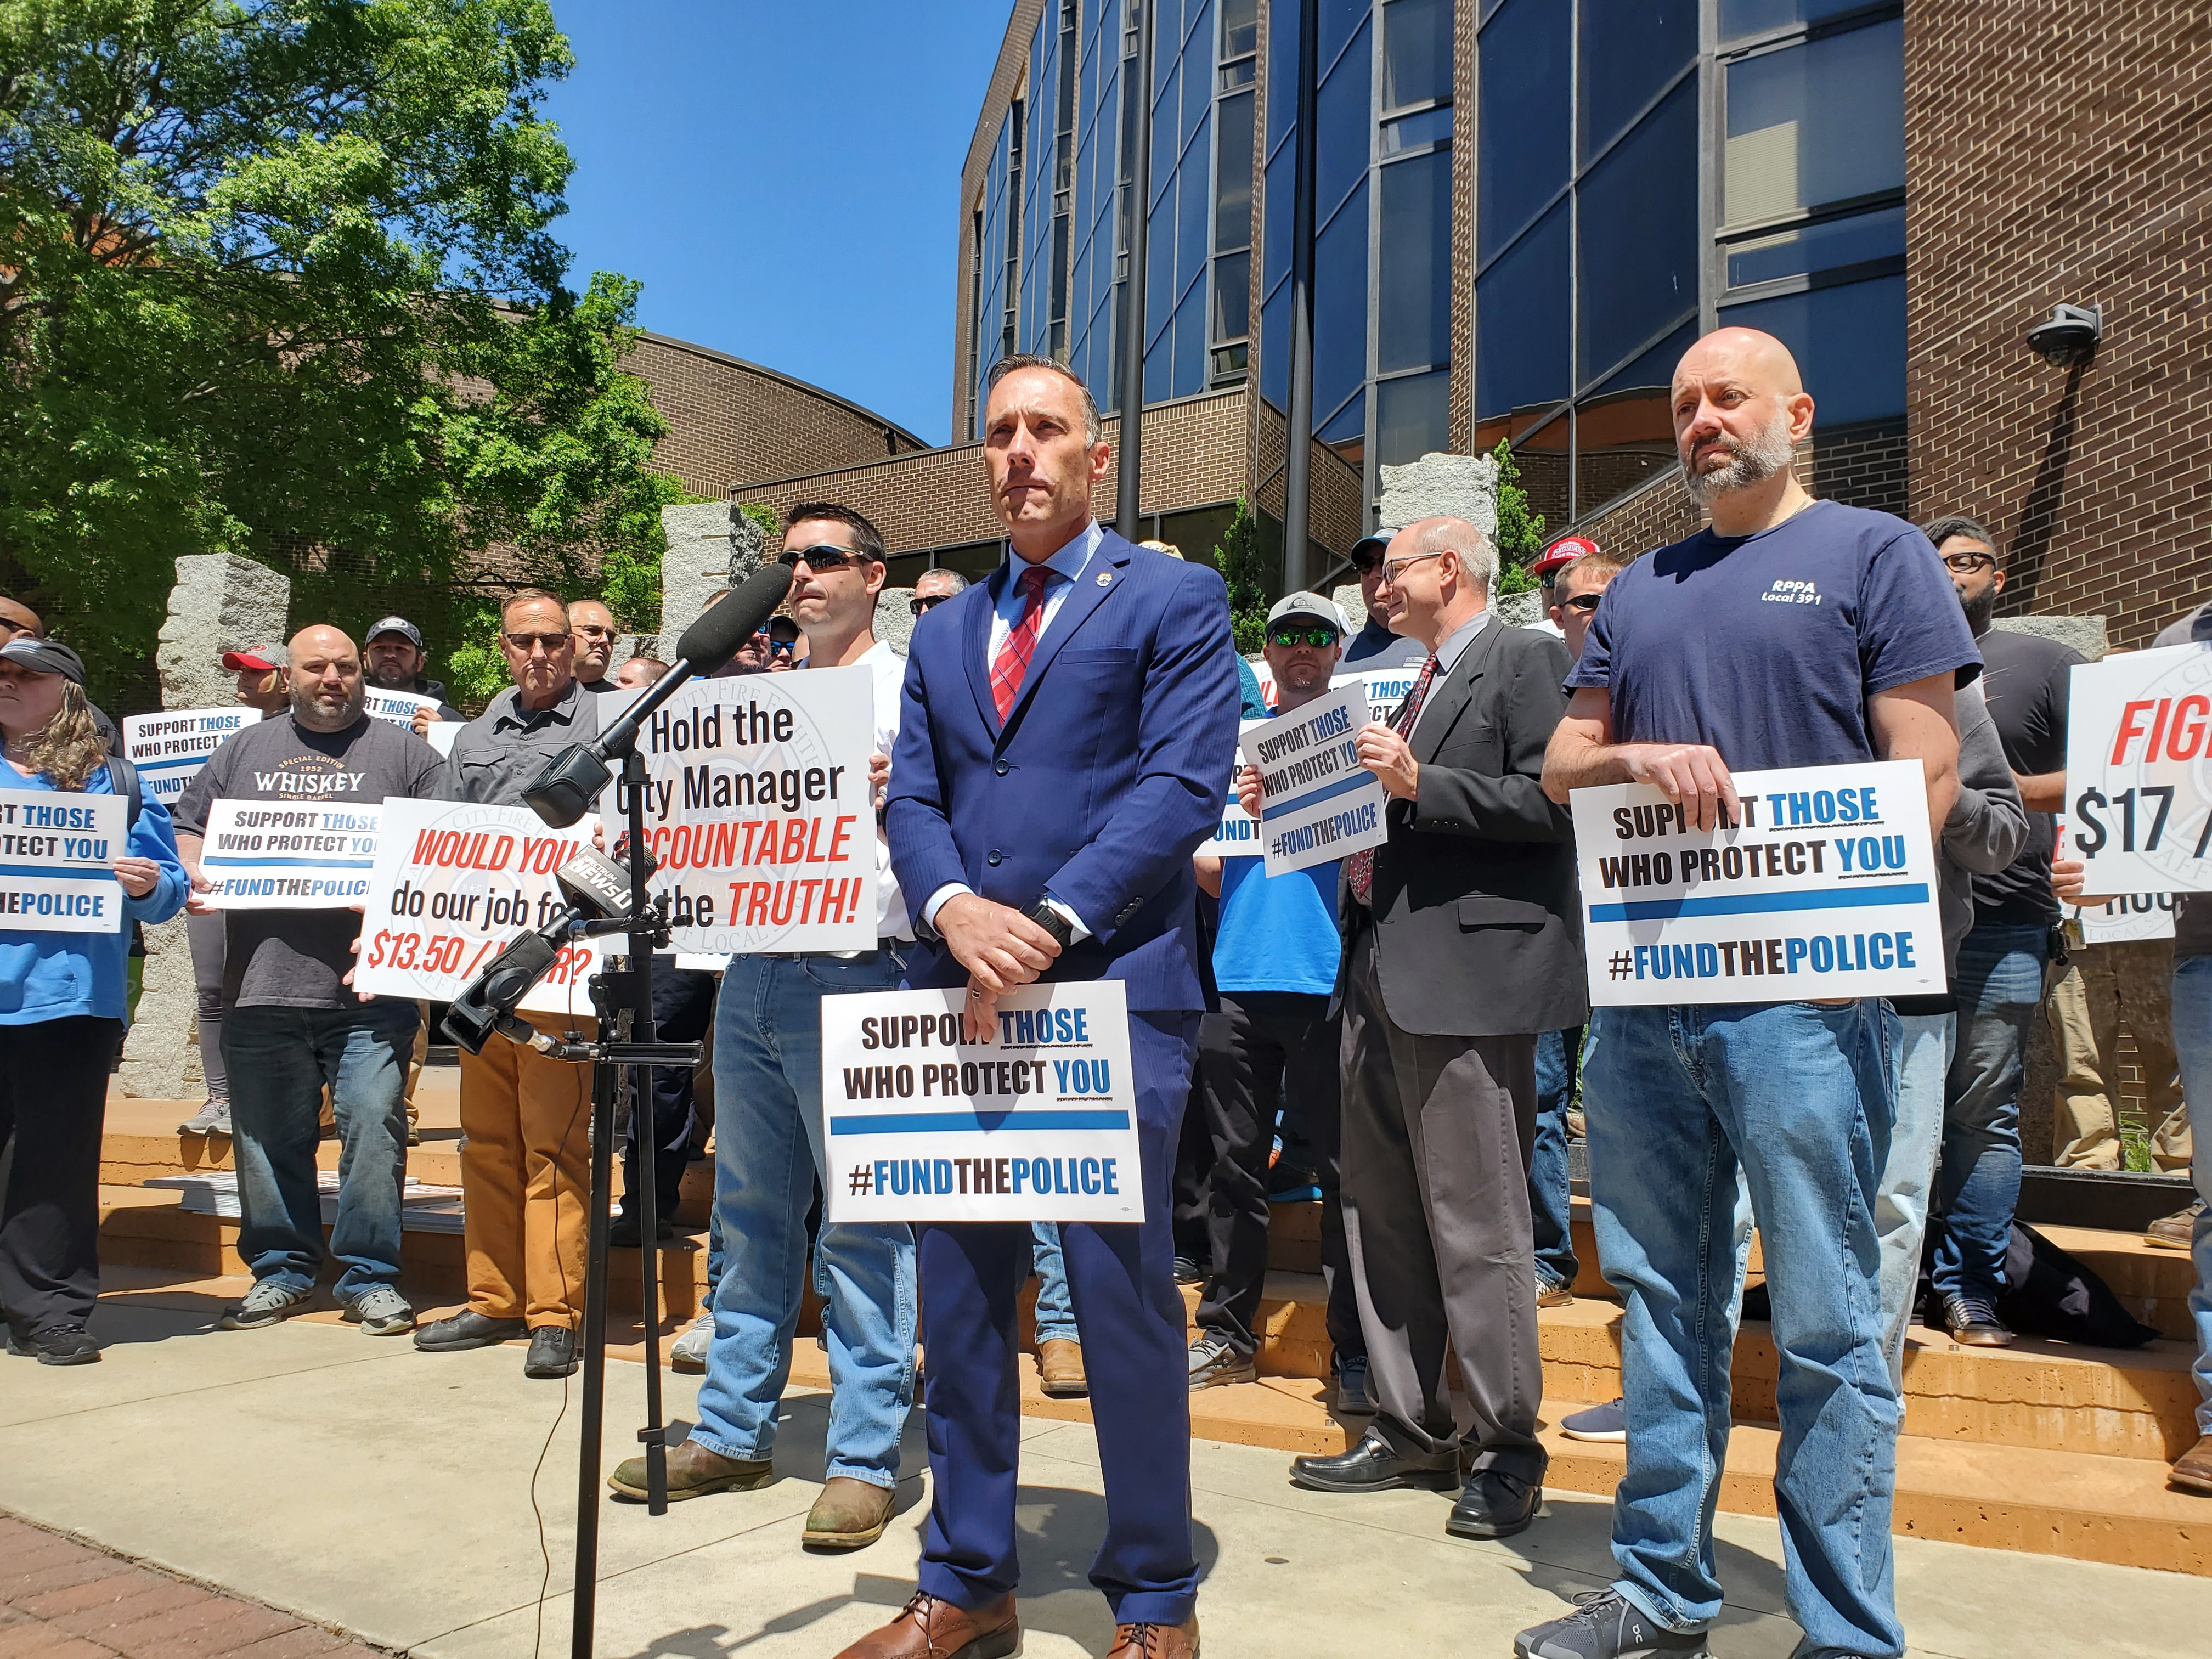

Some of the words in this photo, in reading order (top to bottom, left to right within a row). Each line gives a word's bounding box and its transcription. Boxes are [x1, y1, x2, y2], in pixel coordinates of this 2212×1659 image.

[1761, 591, 1795, 603] Local
[1796, 594, 1822, 605] 391
[1771, 580, 1815, 594] RPPA
[139, 719, 196, 738] SUPPORT
[199, 716, 241, 731] THOSE
[651, 704, 721, 753] Hold
[733, 700, 793, 745] the
[1257, 723, 1310, 764] SUPPORT
[1308, 705, 1351, 741] THOSE
[2111, 694, 2212, 765] FIG
[132, 742, 161, 758] WHO
[165, 735, 219, 754] PROTECT
[278, 755, 313, 769] SPECIAL
[253, 771, 367, 794] WHISKEY
[1263, 769, 1289, 798] WHO
[1289, 747, 1340, 787] PROTECT
[1338, 740, 1358, 770] YO
[617, 773, 673, 821] Cty
[684, 764, 845, 812] Manager
[1767, 787, 1880, 826] THOSE
[23, 805, 95, 828] THOSE
[234, 811, 319, 827] SUPPORT
[323, 813, 378, 830] THOSE
[1272, 802, 1377, 859] #FUNDTHEPOLICE
[2075, 786, 2175, 859] $17
[0, 834, 58, 857] TECT
[64, 837, 108, 859] YOU
[218, 833, 263, 850] WHO
[266, 835, 348, 852] PROTECT
[352, 837, 377, 853] YO
[412, 828, 514, 871] WOULD
[1599, 851, 1672, 889] WHO
[1680, 840, 1826, 883] PROTECT
[1834, 834, 1906, 871] YOU
[208, 878, 370, 896] #FUNDTHEPOLIC
[583, 855, 618, 882] SPECTRUM
[391, 880, 425, 917] do
[432, 892, 481, 922] our
[481, 888, 528, 932] job
[729, 877, 863, 927] TRUTH!
[368, 928, 465, 974] $13.50
[1608, 931, 1916, 981] #FUNDTHEPOLICE
[998, 1008, 1089, 1043] THOSE
[843, 1064, 914, 1100] WHO
[922, 1060, 1047, 1097] PROTECT
[1053, 1059, 1111, 1094] YOU
[849, 1158, 1119, 1196] #FUNDTHEPOLICE
